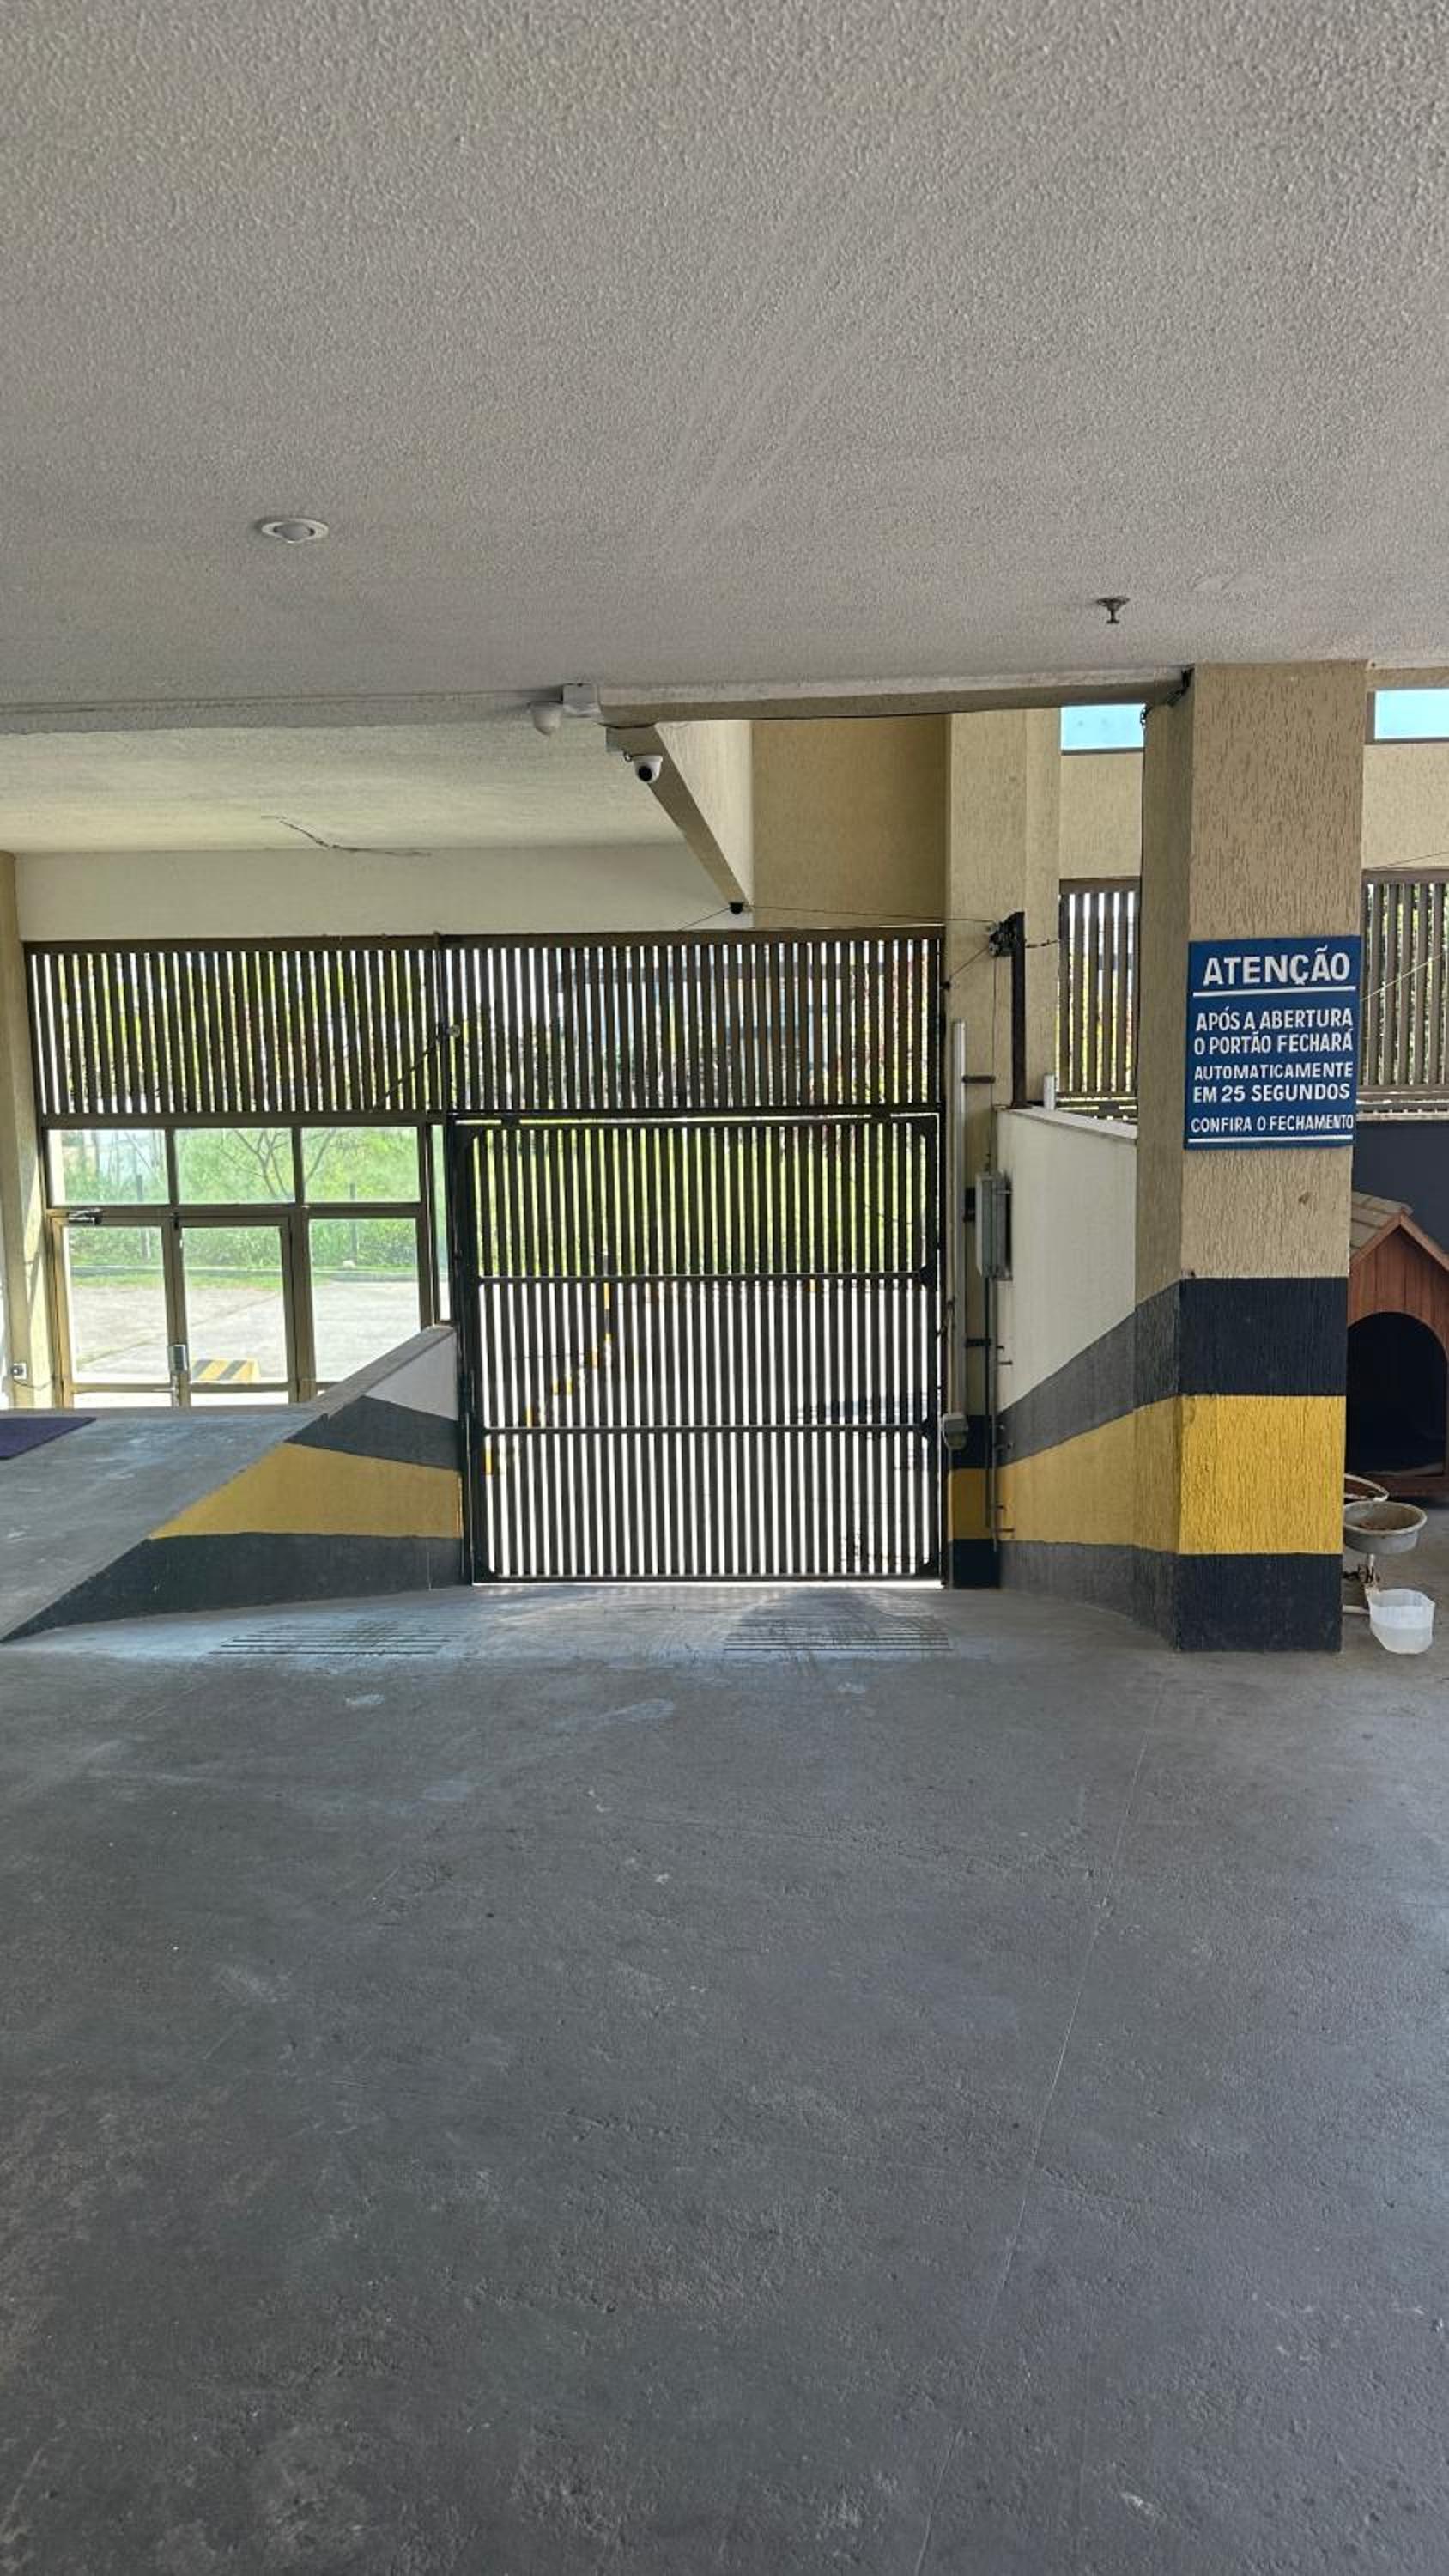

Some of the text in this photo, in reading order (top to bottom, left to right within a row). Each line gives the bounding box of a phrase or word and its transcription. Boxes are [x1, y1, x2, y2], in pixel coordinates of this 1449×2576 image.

[1203, 945, 1350, 986] ATENÇÃO
[1196, 1006, 1353, 1031] APÓS A ABERTURA
[1195, 1029, 1353, 1055] O PORTÃO FECHARÁ
[1195, 1062, 1353, 1081] AUTOMATICAMENTE
[1193, 1084, 1350, 1103] EM 25 SEGUNDOS
[1191, 1115, 1354, 1133] CONFIRA O FECHAMENTO
